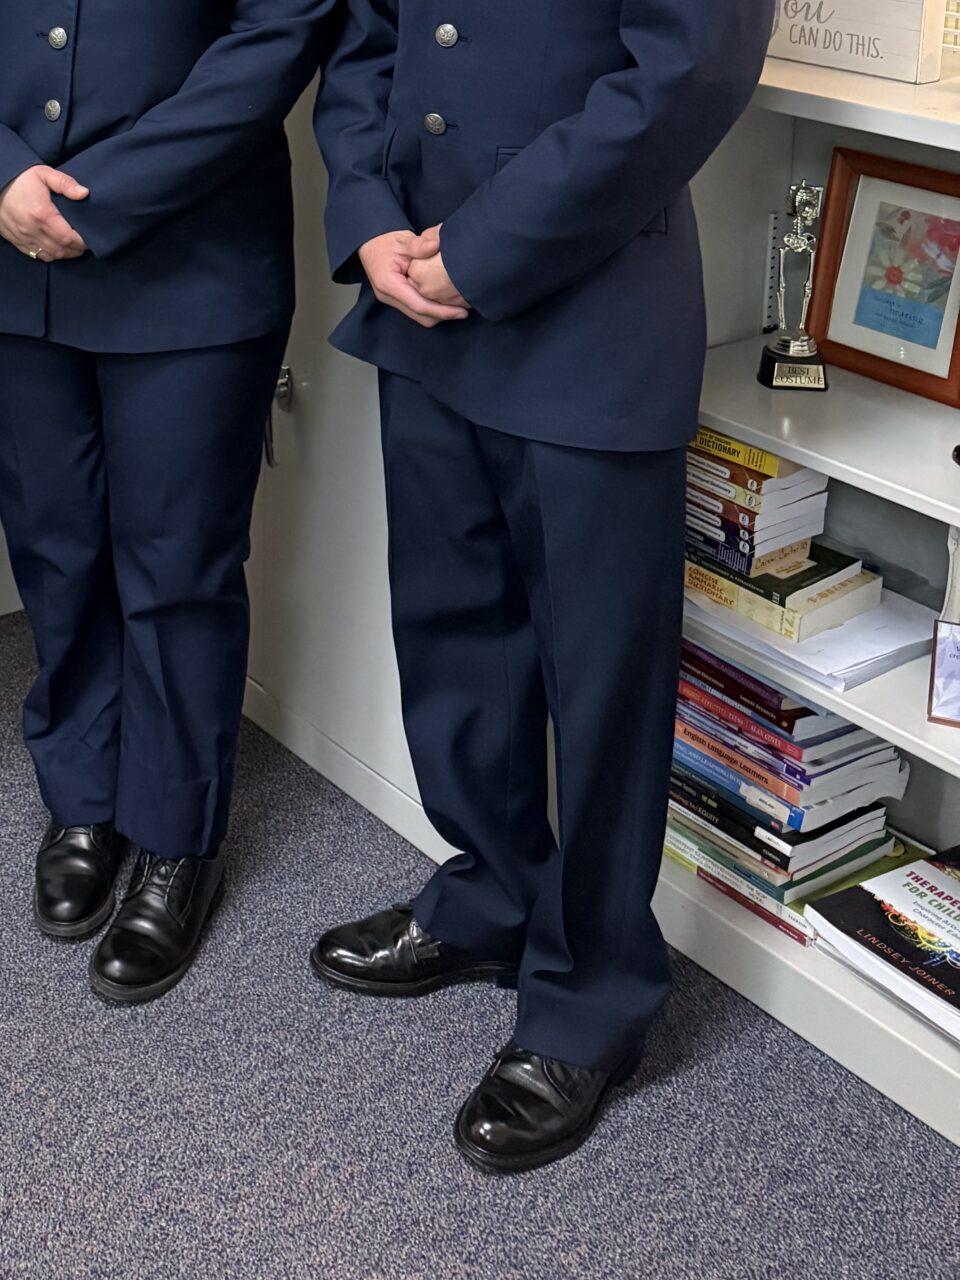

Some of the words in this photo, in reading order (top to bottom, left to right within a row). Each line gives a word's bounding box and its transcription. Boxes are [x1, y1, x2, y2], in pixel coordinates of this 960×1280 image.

[789, 23, 819, 48] CAN
[823, 29, 843, 52] DO
[846, 33, 884, 60] THIS.
[775, 375, 824, 385] COSTUME
[788, 366, 811, 375] BEST
[699, 437, 741, 458] DICTIONARY
[688, 567, 719, 586] CONCISE
[688, 578, 734, 606] DICTIONARY
[683, 728, 707, 746] English
[707, 741, 739, 766] Language
[740, 762, 769, 785] Learners
[902, 881, 928, 900] FOR
[856, 928, 909, 964] LINDSEY
[909, 965, 956, 997] JOINER
